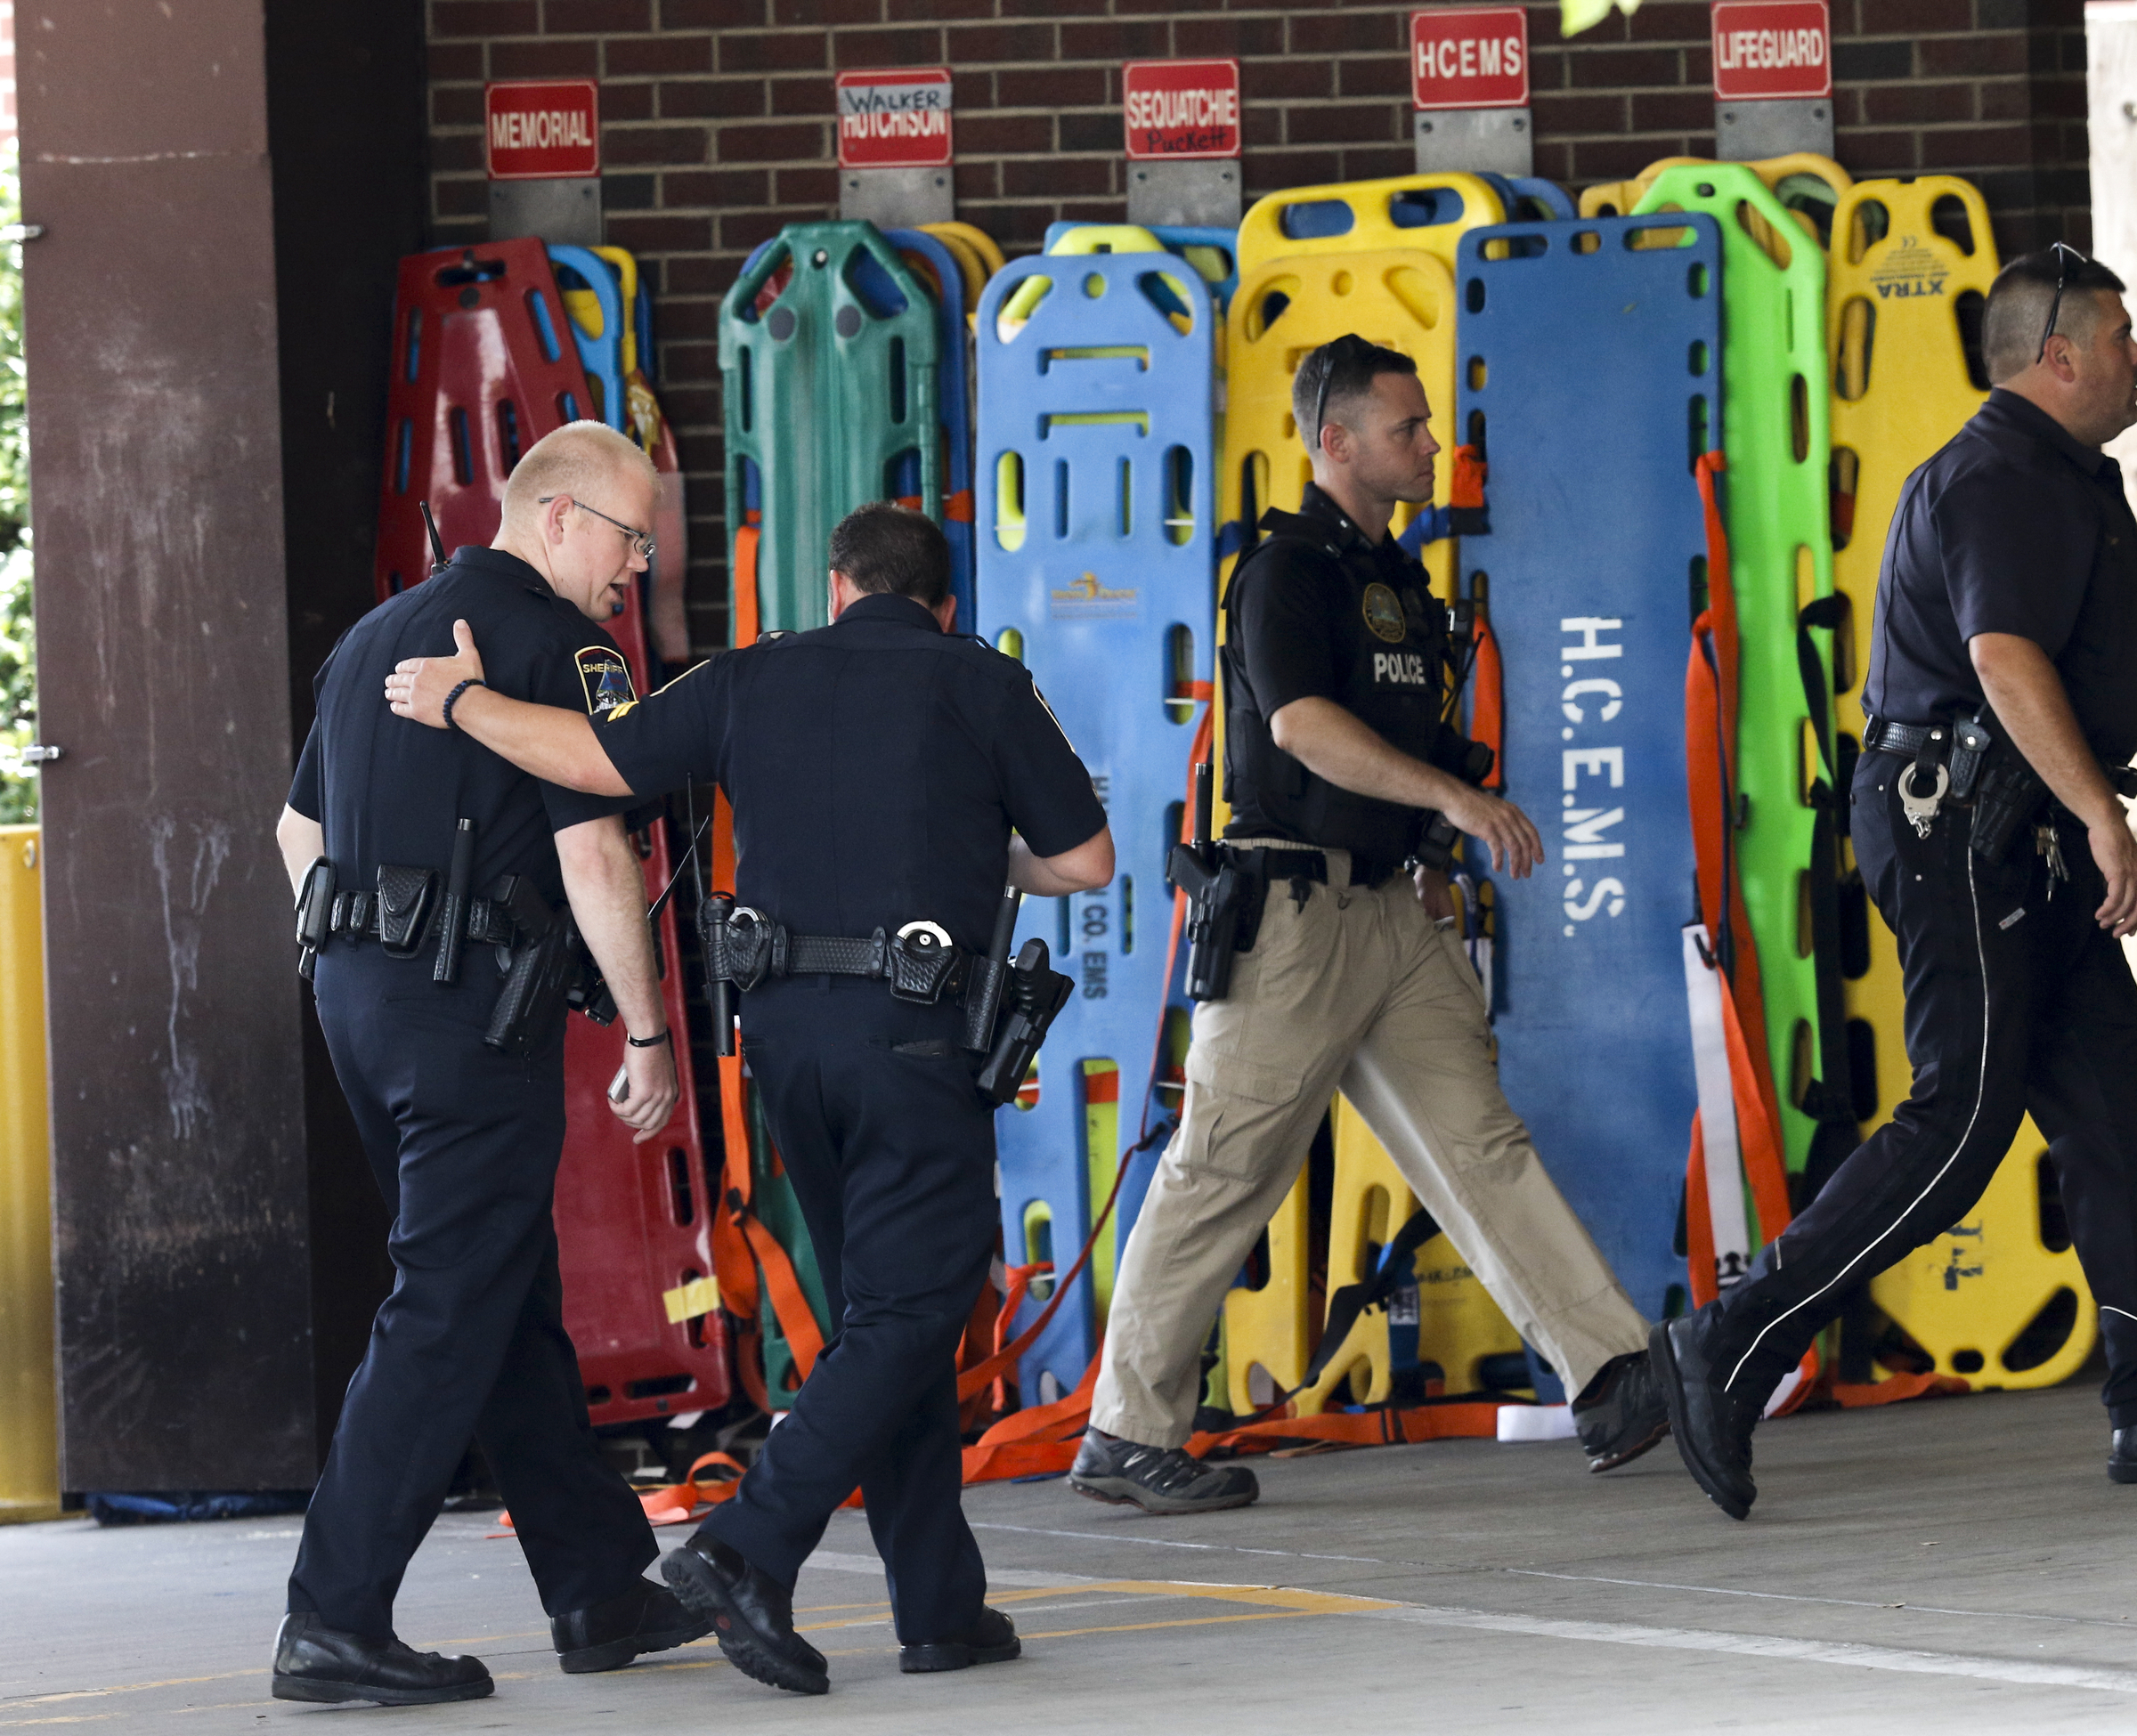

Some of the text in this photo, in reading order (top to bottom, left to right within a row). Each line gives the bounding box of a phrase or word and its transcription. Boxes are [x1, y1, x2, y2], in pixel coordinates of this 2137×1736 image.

[1417, 37, 1522, 78] HCEMS
[1719, 28, 1824, 69] LIFEGUARD
[844, 86, 940, 114] WALKER
[1128, 88, 1236, 129] SEQUATCHIE
[492, 110, 592, 150] MEMORIAL
[1146, 126, 1226, 153] Puckett
[1876, 281, 1944, 298] XTRA
[583, 663, 622, 673] SHERIFF
[1373, 653, 1426, 685] POLICE
[1561, 617, 1626, 937] H.C.E.M.S.
[1083, 905, 1108, 942] CO.
[1084, 952, 1109, 999] EMS
